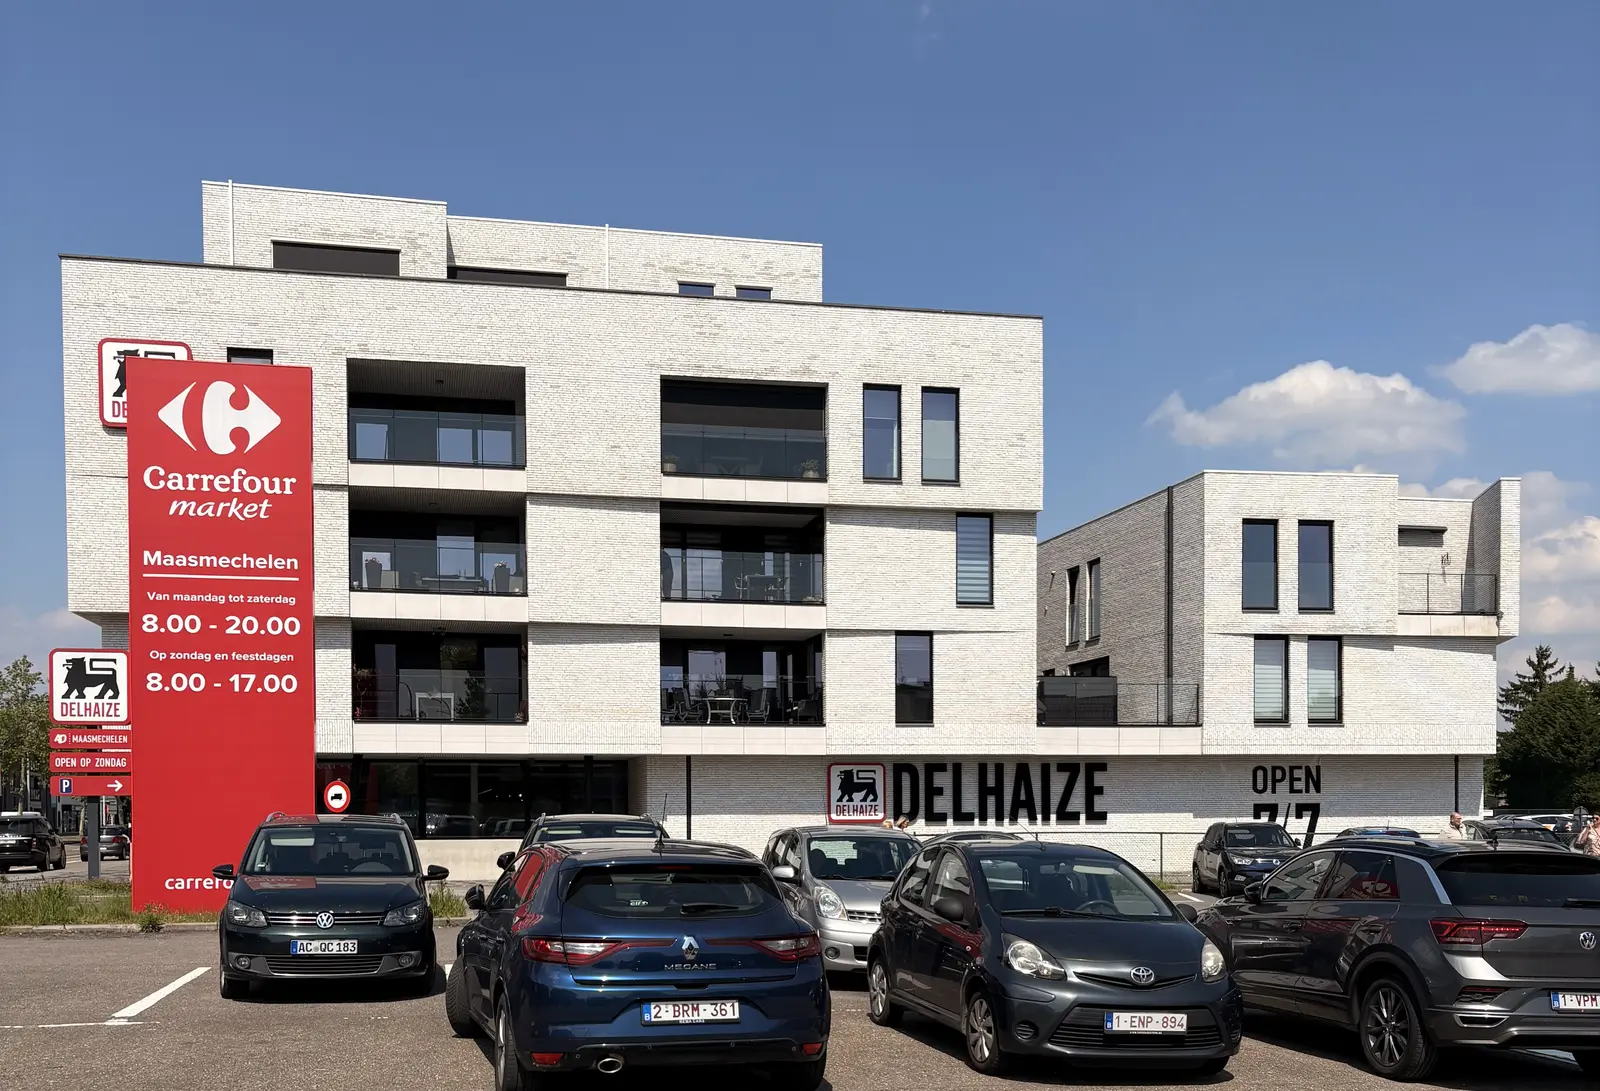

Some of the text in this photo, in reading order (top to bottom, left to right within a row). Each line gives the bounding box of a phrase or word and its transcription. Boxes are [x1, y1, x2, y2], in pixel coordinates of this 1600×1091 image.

[143, 465, 297, 495] Carrefour
[168, 497, 273, 521] market
[143, 550, 299, 570] Maasmechelen
[147, 591, 296, 606] Van maandag tot zaterdag
[141, 613, 202, 634] 8.00
[225, 615, 301, 635] 20.00
[149, 650, 167, 661] Op
[169, 651, 212, 662] zondag
[231, 651, 294, 663] feestdagen
[146, 672, 206, 692] 8.00
[228, 674, 298, 693] 17.00
[60, 702, 121, 717] DELHAIZE
[72, 735, 128, 743] MAASMECHELEN
[55, 758, 127, 767] OPEN OP ZONDAG
[62, 780, 70, 792] P
[1252, 765, 1321, 794] OPEN
[892, 763, 1108, 822] DELHAIZE
[836, 804, 879, 817] DELHAIZE
[299, 942, 356, 952] AC QC 183
[644, 1002, 736, 1021] B 2-BRM-361
[1115, 1015, 1185, 1029] 1-ENP-894
